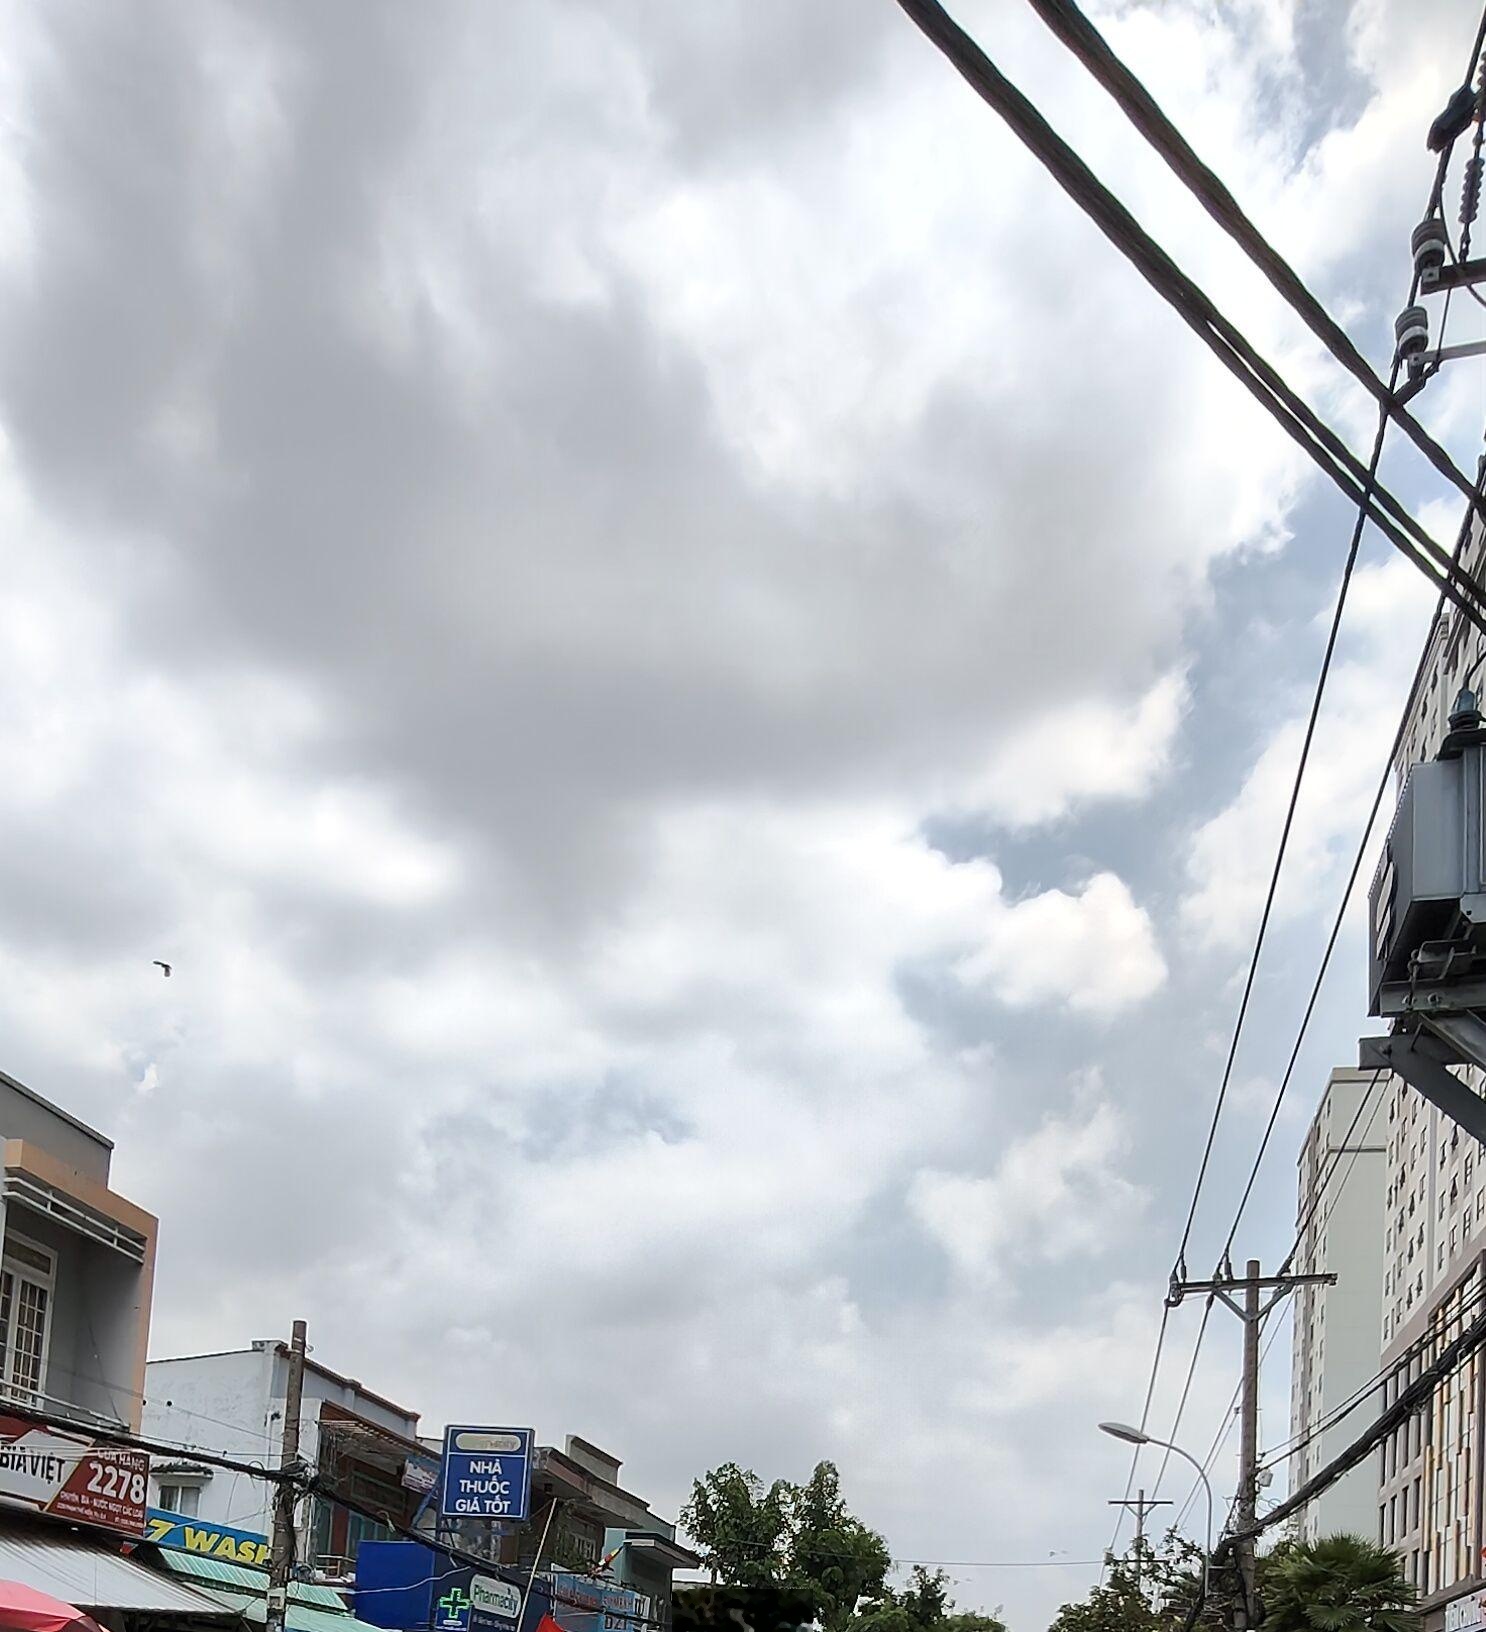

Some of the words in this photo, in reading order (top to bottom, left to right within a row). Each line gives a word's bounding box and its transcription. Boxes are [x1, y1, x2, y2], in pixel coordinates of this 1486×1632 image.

[30, 1451, 66, 1484] VIỆT
[87, 1461, 145, 1505] 2278
[469, 1458, 502, 1475] NHÀ
[460, 1475, 511, 1495] THUỐC
[455, 1496, 481, 1513] GIÁ
[484, 1494, 511, 1514] TỐT
[184, 1526, 271, 1566] WASH
[474, 1583, 519, 1616] Pharmacity
